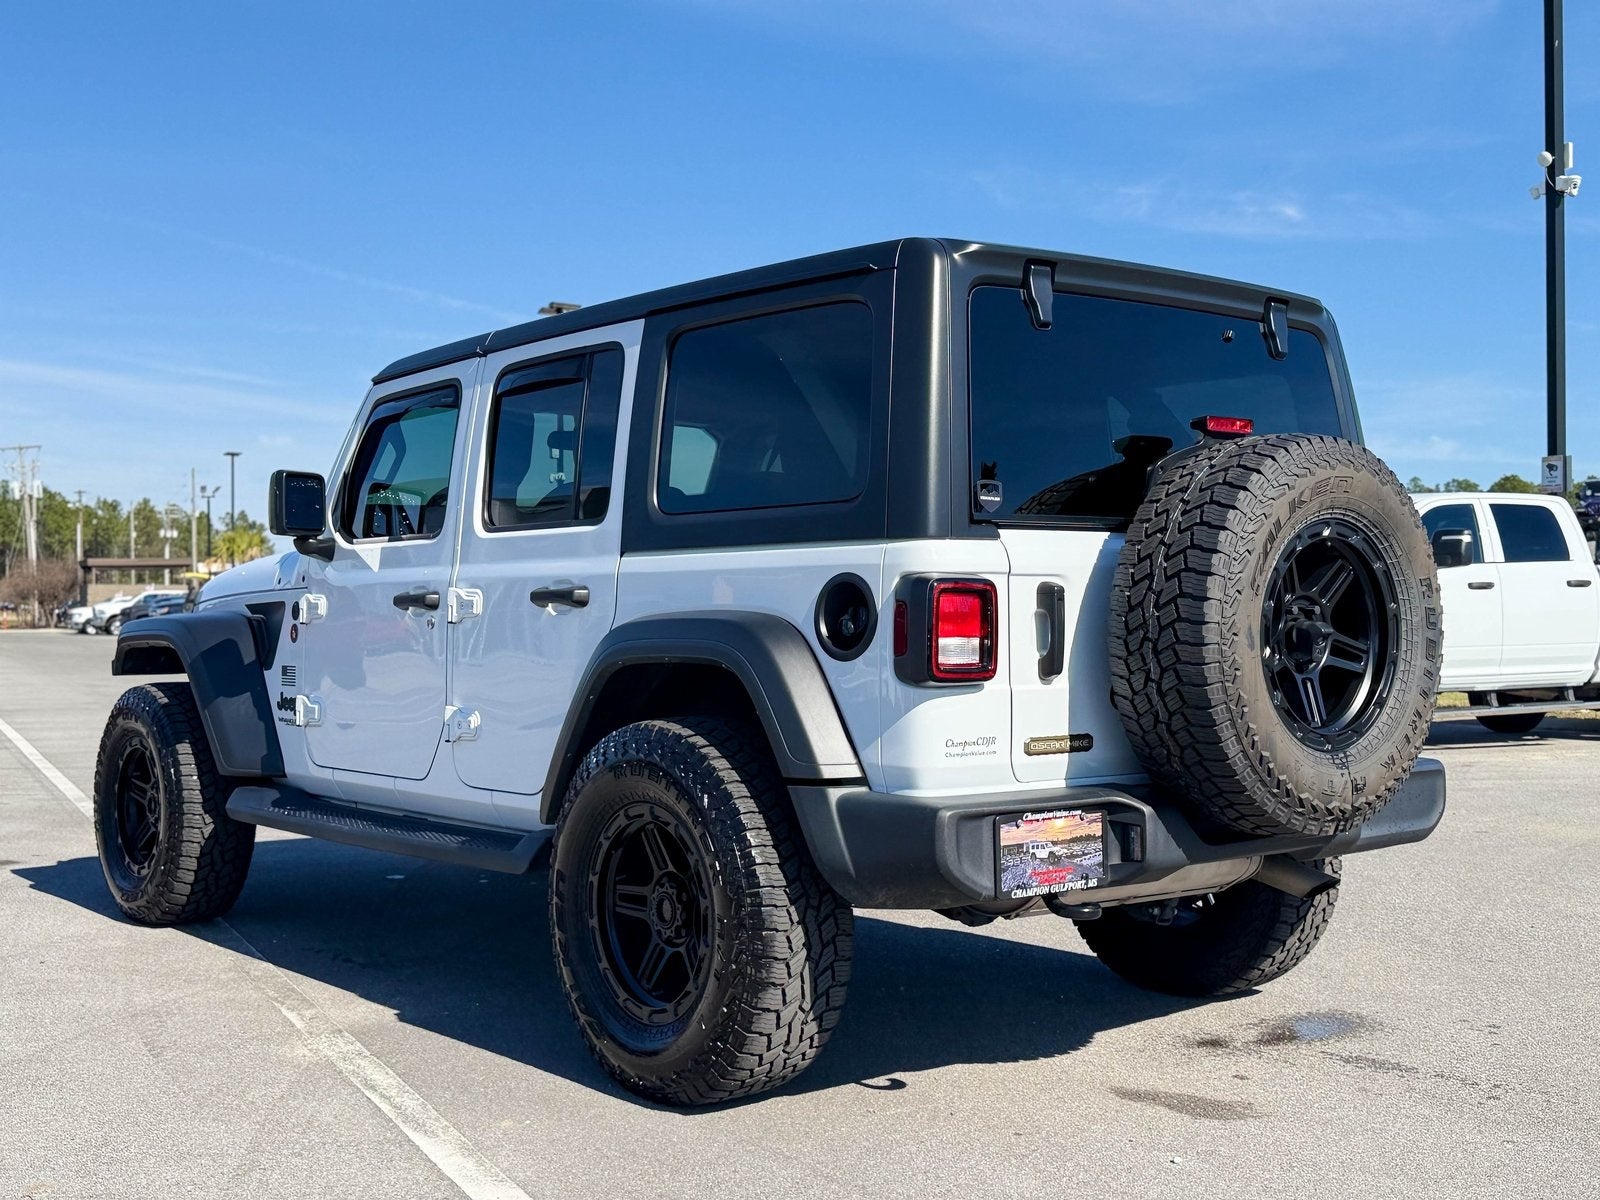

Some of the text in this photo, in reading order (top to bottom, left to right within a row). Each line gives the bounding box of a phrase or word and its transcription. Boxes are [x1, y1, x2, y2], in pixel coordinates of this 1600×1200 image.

[1250, 475, 1355, 601] FALKEN
[1379, 577, 1438, 779] RUBITREK
[1030, 739, 1090, 750] OSCAR MIKE
[1011, 885, 1051, 899] CHAMPION
[1087, 878, 1098, 888] MS
